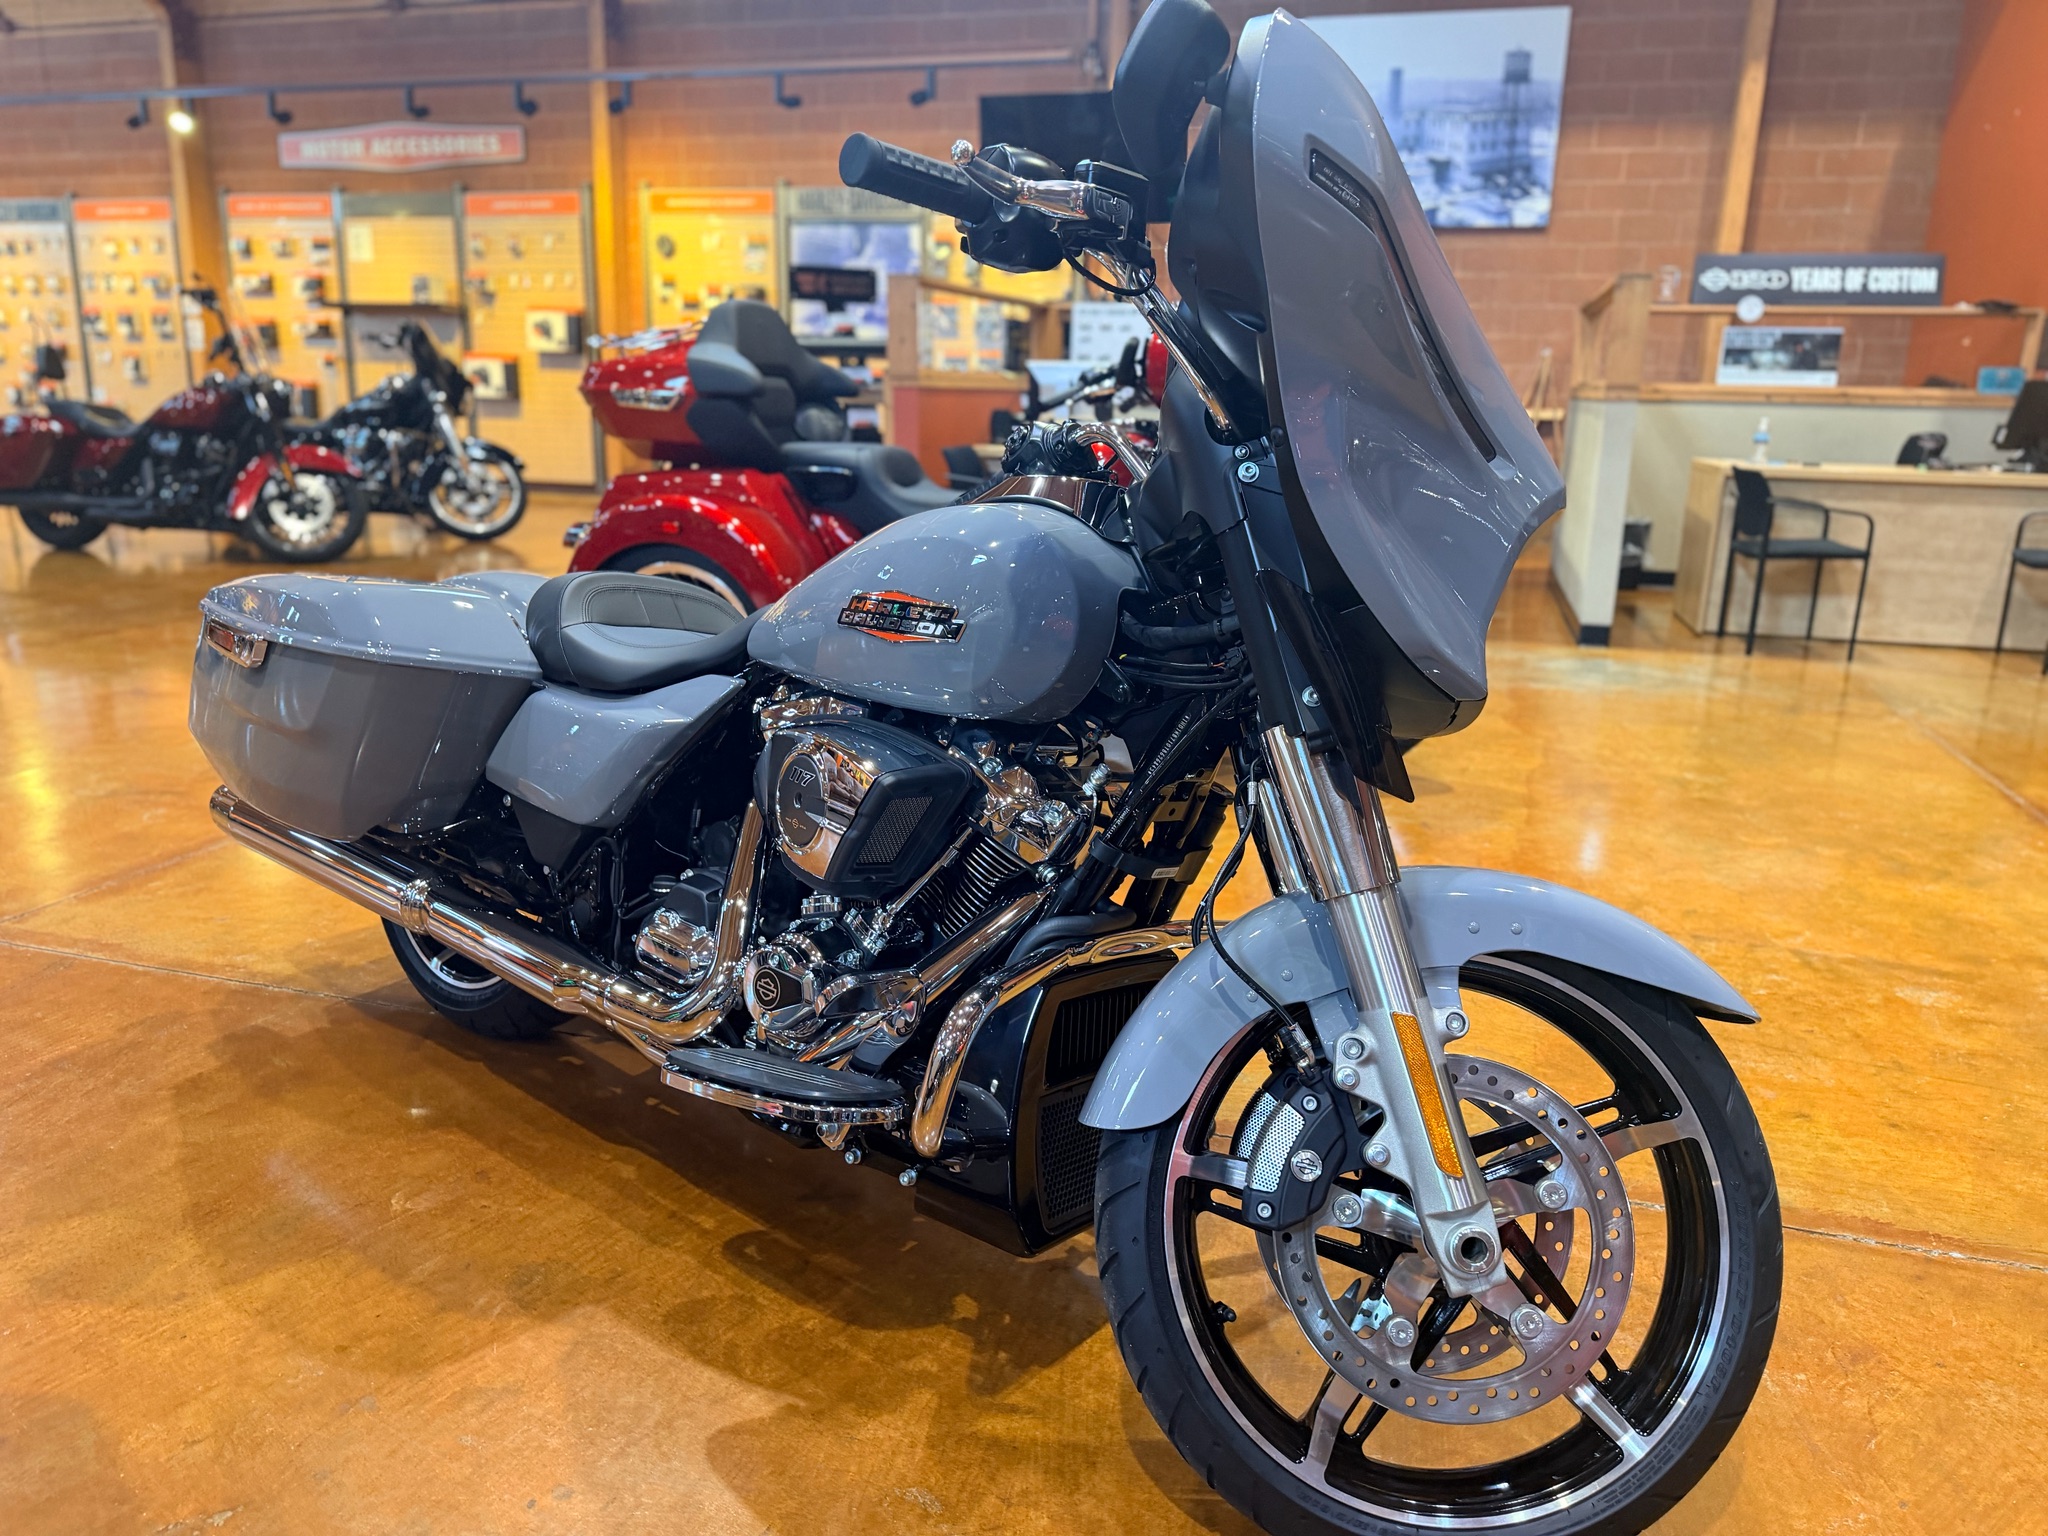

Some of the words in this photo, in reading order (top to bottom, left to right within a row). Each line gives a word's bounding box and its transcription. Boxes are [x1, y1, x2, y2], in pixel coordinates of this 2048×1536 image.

[302, 138, 363, 158] MOTOR
[371, 134, 499, 157] ACCESSORIES
[1790, 267, 1843, 293] YEARS
[1844, 267, 1867, 293] OF
[1867, 267, 1939, 293] CUSTOM
[841, 610, 958, 637] DAVIDSON
[790, 766, 816, 787] 117
[1735, 1201, 1751, 1309] DUNLOP
